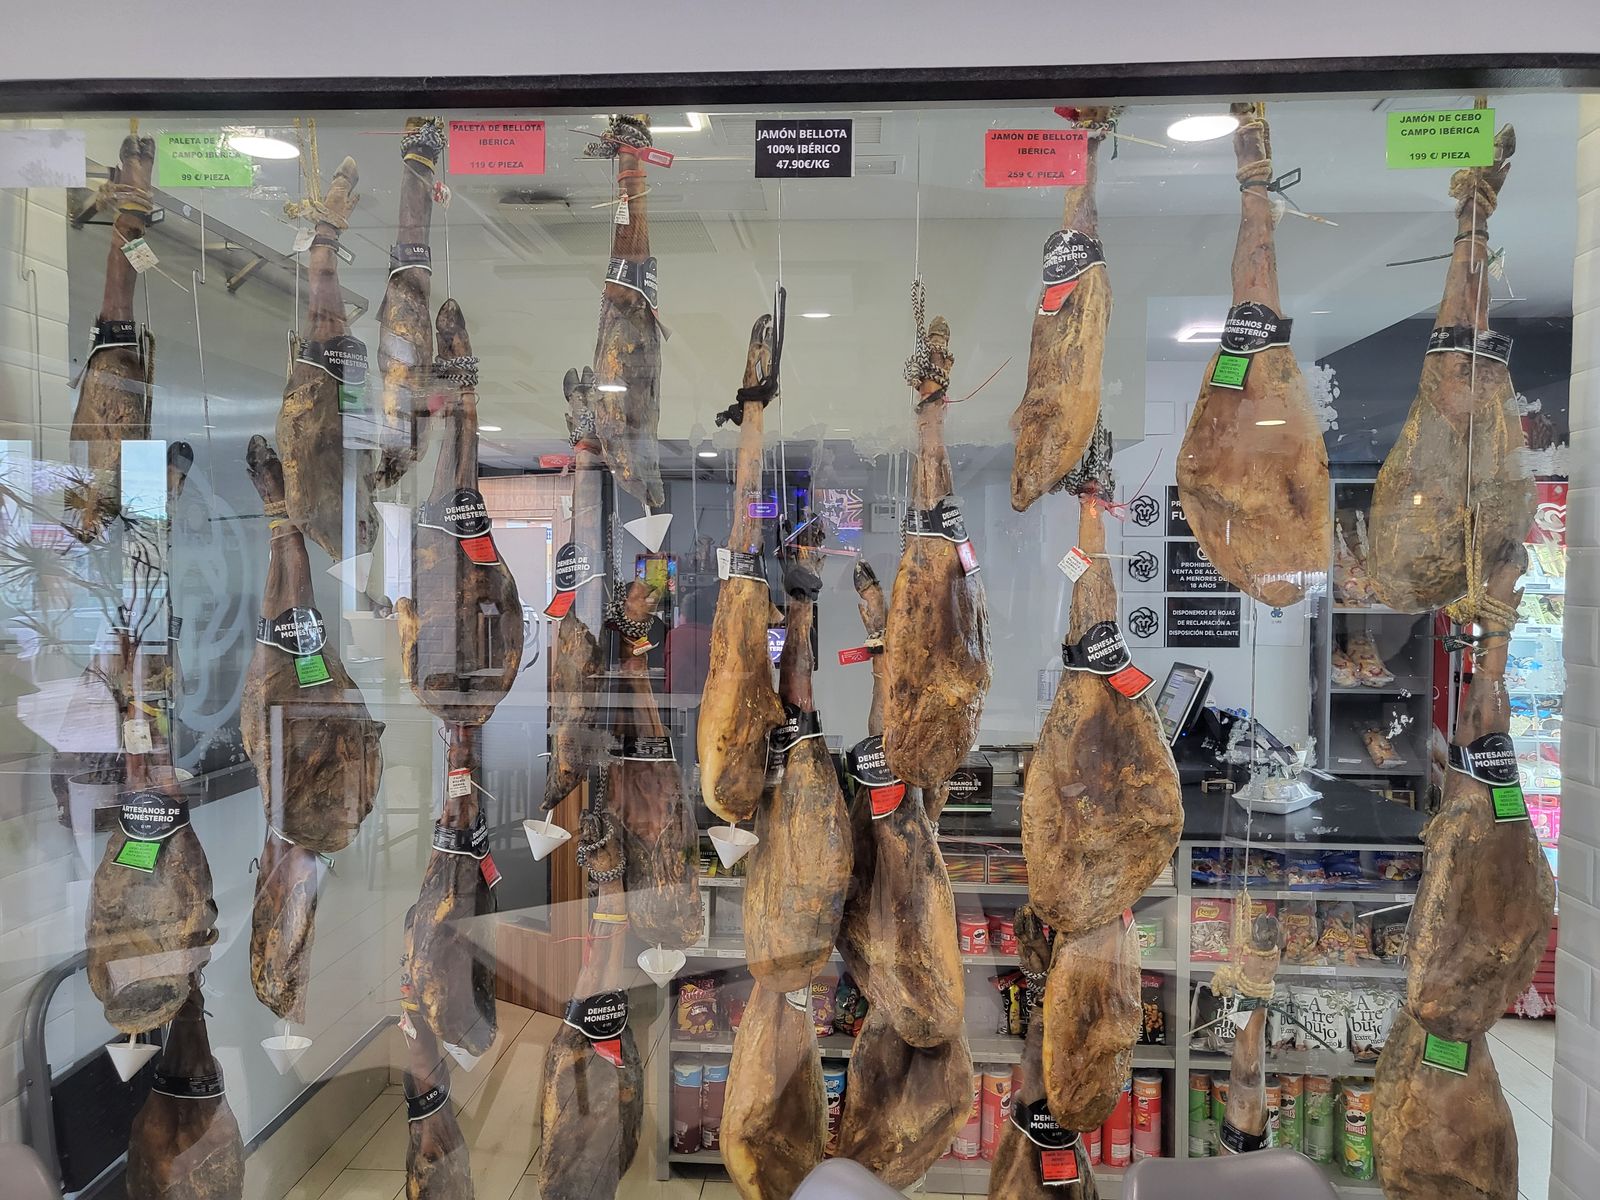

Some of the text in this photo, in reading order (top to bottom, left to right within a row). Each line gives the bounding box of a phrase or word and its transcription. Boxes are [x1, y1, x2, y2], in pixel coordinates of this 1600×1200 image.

[1399, 113, 1482, 124] JAMÓN DE CEBO
[453, 124, 542, 132] PALETA DE BELLOTA
[1400, 126, 1480, 136] CAMPO IBÉRICA
[757, 128, 847, 141] JAMÓN BELLOTA
[991, 132, 1084, 143] JAMÓN DE BELLOTA
[168, 137, 200, 145] PALETA
[203, 137, 216, 145] DE
[766, 142, 841, 154] 100% IBÉRICO
[172, 151, 203, 159] CAMPO
[1409, 152, 1427, 160] 199
[1440, 151, 1470, 160] PIEZA
[776, 159, 830, 170] 47.90€/KG
[181, 173, 192, 181] 99
[204, 173, 230, 181] PIEZA
[1007, 171, 1024, 179] 259
[1037, 170, 1065, 179] PIEZA
[1071, 244, 1084, 253] DE
[1264, 323, 1278, 333] DE
[323, 349, 363, 361] ARTESANOS
[445, 503, 485, 515] DEHESA DE
[578, 556, 588, 564] DE
[1087, 639, 1111, 655] DEHESA
[858, 751, 885, 763] DEHES
[122, 805, 166, 815] ARTESANOS
[123, 813, 174, 823] MONESTERIO
[584, 1009, 626, 1023] MONESTERIO
[587, 1006, 616, 1016] DEHESA
[426, 1090, 438, 1101] LEO
